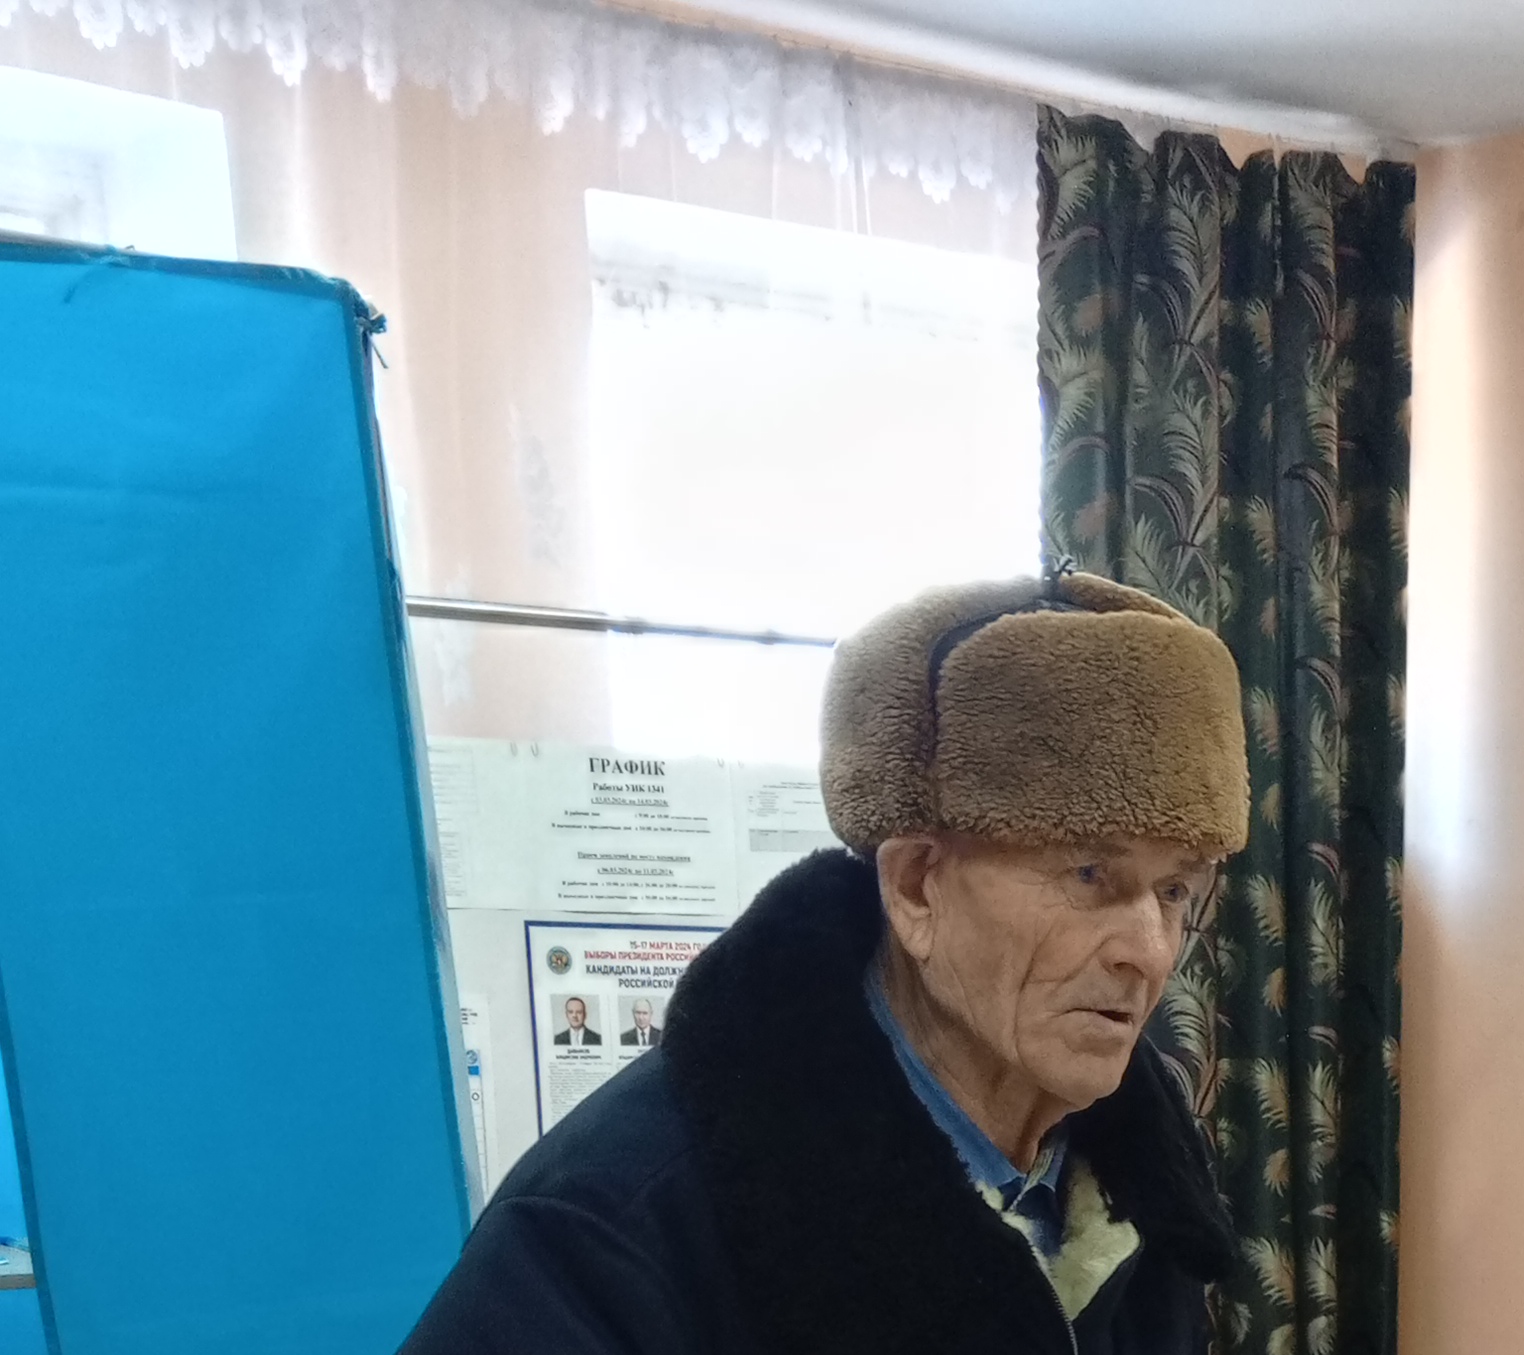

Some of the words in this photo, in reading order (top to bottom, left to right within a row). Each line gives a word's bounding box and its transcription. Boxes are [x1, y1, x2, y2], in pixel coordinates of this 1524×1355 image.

[588, 757, 666, 776] ГРАФИК
[625, 784, 645, 793] УИК
[649, 941, 674, 951] МАРТА
[584, 950, 617, 960] ВЫБОРЫ
[618, 951, 665, 961] ПРЕЗИДЕНТА
[586, 964, 638, 976] КАНДИДАТЫ
[640, 965, 651, 976] НА
[618, 977, 676, 989] РОССИЙСКОЙ
